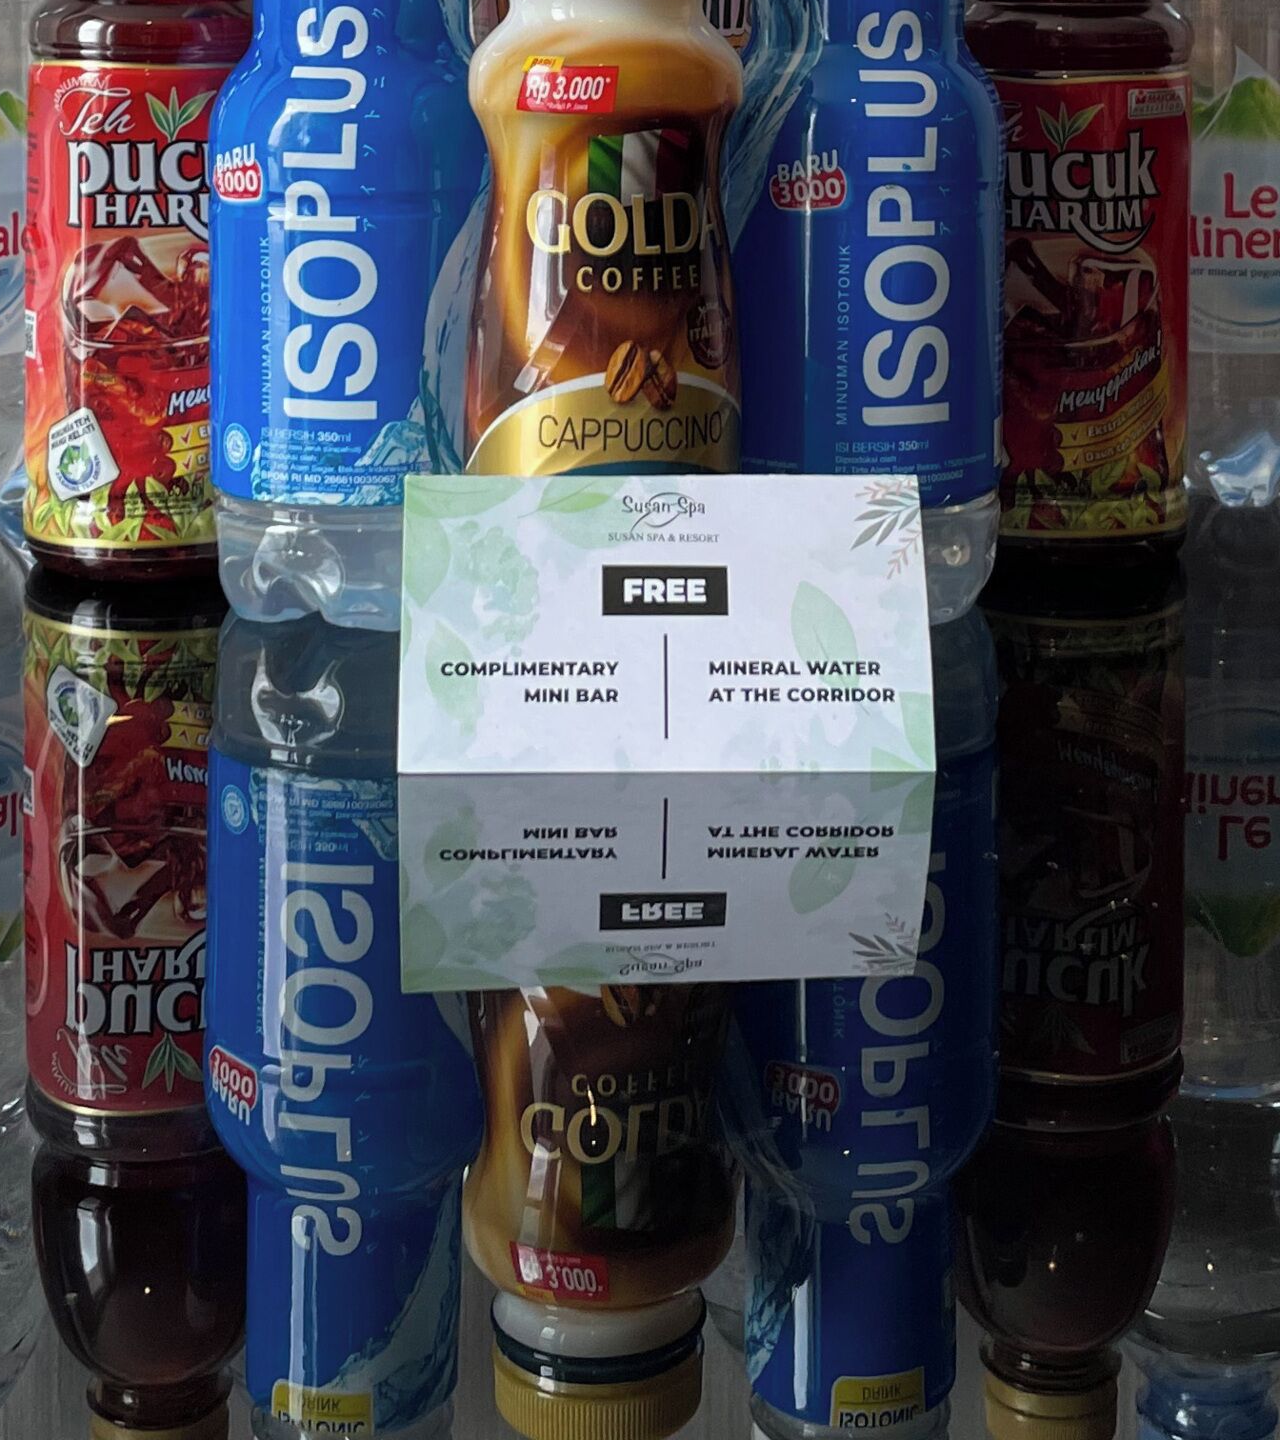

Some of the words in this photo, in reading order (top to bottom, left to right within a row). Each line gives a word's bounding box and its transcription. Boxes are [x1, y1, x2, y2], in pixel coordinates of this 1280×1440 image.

[59, 76, 136, 136] Teh
[525, 75, 551, 105] Rp
[216, 142, 256, 174] BARU
[776, 148, 839, 184] BARU
[1006, 131, 1161, 200] ucuk
[1223, 171, 1279, 219] Le
[282, 5, 379, 421] ISOPLUS
[525, 187, 721, 258] GOLDA
[856, 9, 951, 427] ISOPLUS
[258, 236, 272, 323] ISOTONIK
[575, 264, 700, 294] COFFEE
[837, 244, 852, 332] ISOTONIK
[261, 329, 272, 415] MINUMAN
[836, 339, 849, 426] MINUMAN
[317, 430, 352, 444] 350ml
[537, 411, 723, 453] CAPPUCCINO
[835, 441, 849, 453] ISI
[851, 441, 895, 453] BERSIH
[898, 439, 929, 452] 350ml
[304, 473, 321, 484] MD
[621, 494, 671, 515] Susan
[677, 494, 706, 519] Spa
[608, 531, 644, 544] SUSAN
[646, 532, 666, 543] SPA
[668, 532, 676, 543] &
[678, 532, 720, 544] RESORT
[622, 577, 708, 605] FREE
[439, 660, 620, 678] COMPLIMENTARY
[708, 660, 801, 677] MINERAL
[807, 660, 881, 677] WATER
[523, 687, 570, 704] MINI
[575, 687, 620, 704] BAR
[708, 686, 735, 704] AT
[740, 686, 781, 703] THE
[787, 686, 896, 704] CORRIDOR
